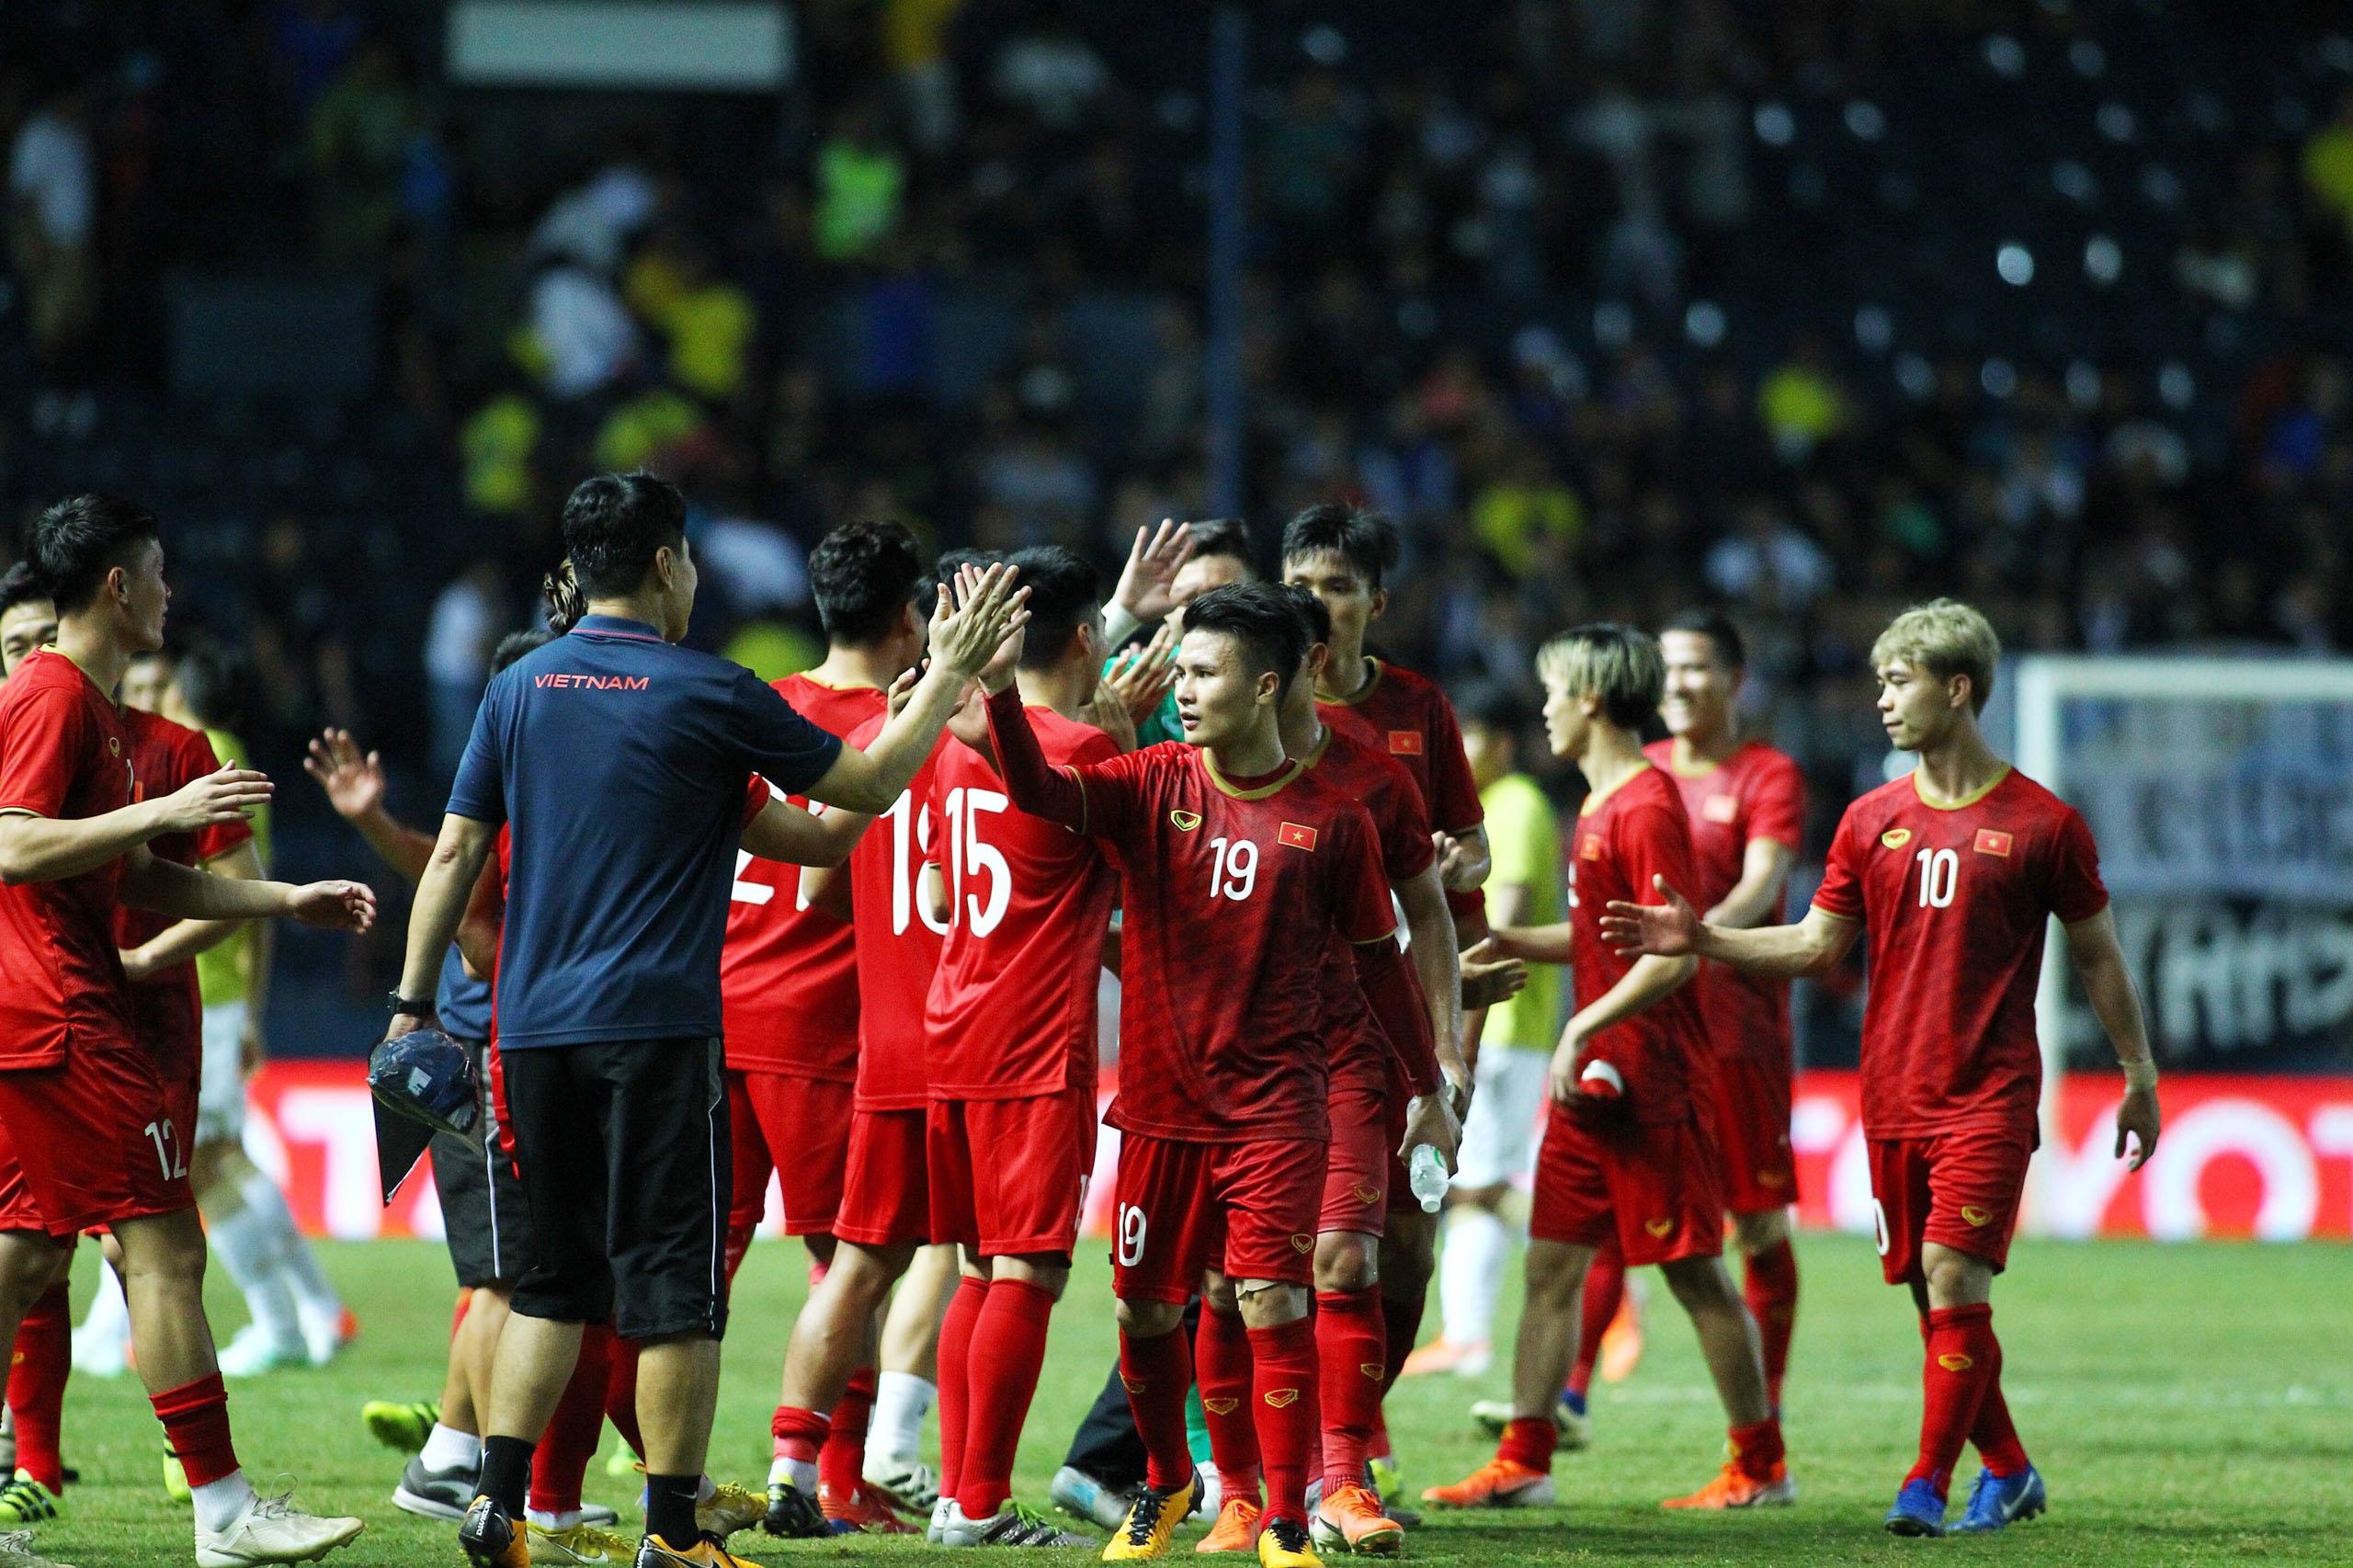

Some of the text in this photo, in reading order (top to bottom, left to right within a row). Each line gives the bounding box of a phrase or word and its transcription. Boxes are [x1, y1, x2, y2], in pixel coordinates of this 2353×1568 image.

[534, 673, 650, 690] VIETNAM
[945, 788, 1012, 937] 15
[1210, 836, 1258, 901] 19
[1916, 847, 1959, 908] 10
[144, 1119, 187, 1181] 12
[1119, 1201, 1147, 1267] 19
